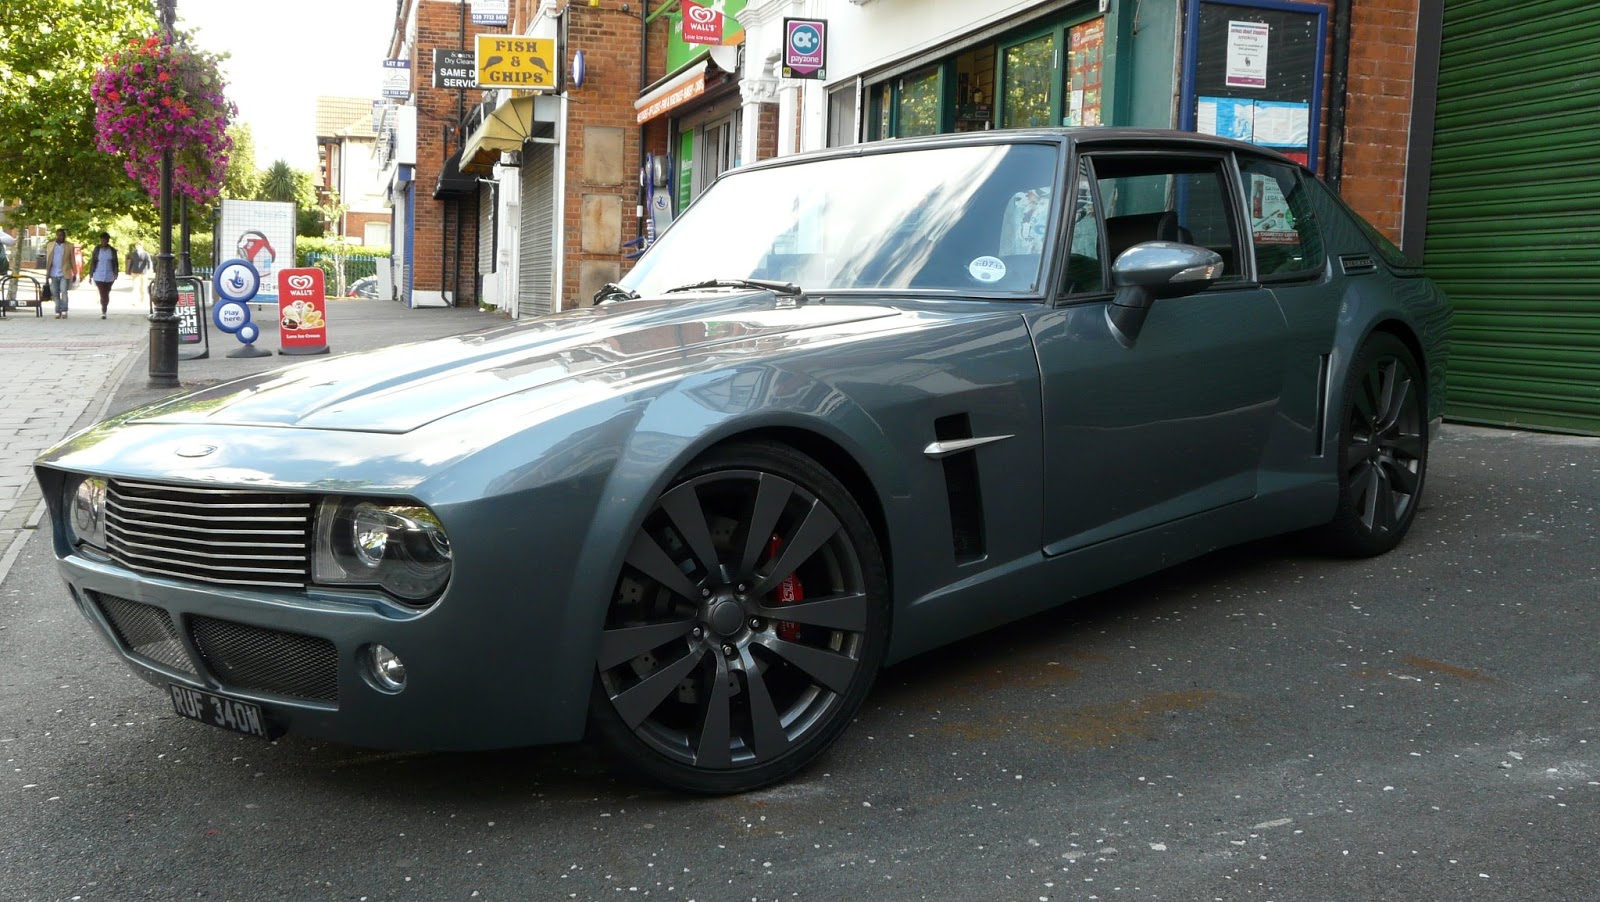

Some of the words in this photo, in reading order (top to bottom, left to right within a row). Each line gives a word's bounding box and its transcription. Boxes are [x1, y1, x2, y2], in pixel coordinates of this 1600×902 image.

[690, 22, 715, 31] WALL'S
[495, 40, 537, 53] FISH
[456, 57, 475, 65] Cleane
[510, 55, 521, 67] &
[790, 55, 819, 64] payzone
[440, 67, 467, 77] SAME
[443, 78, 477, 88] SERVIC
[177, 292, 196, 307] EE
[178, 327, 198, 335] HINE
[171, 685, 204, 720] RUF
[210, 696, 264, 736] 340M
